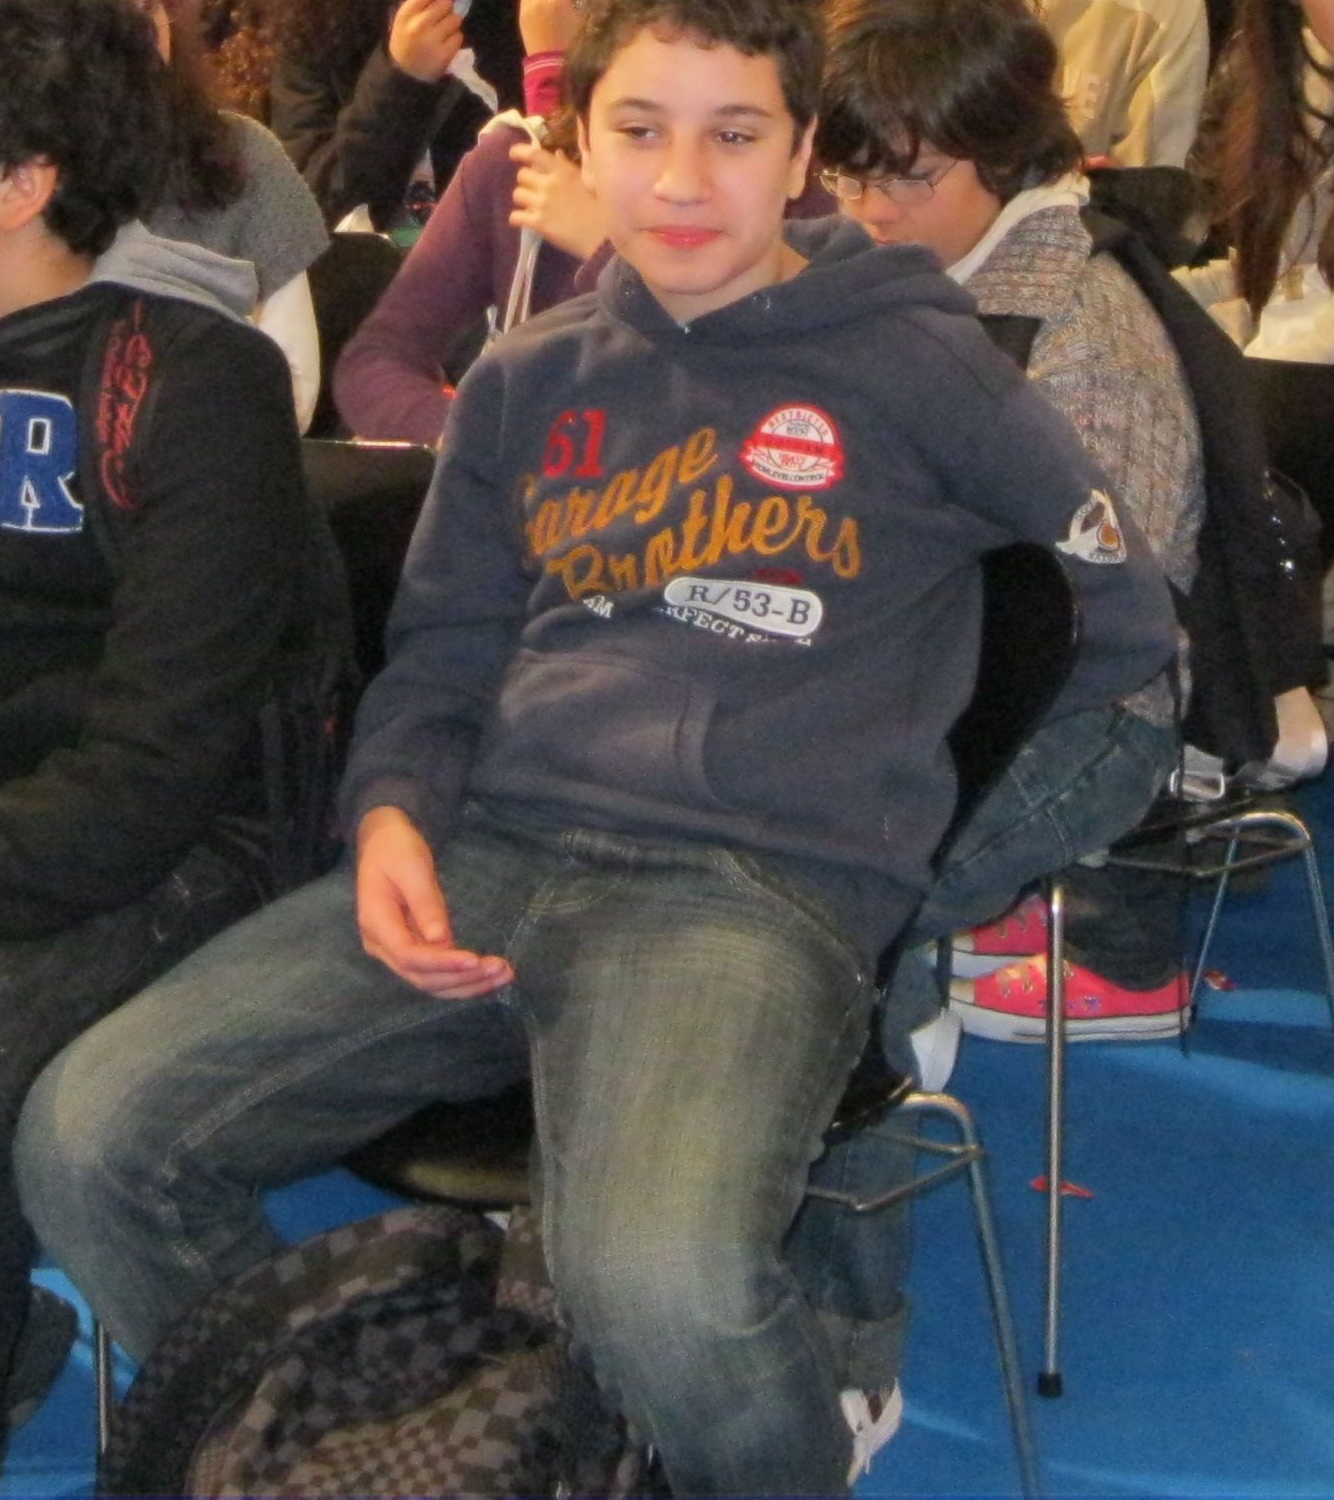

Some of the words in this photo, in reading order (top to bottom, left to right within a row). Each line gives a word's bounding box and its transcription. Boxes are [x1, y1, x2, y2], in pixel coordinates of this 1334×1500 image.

[542, 407, 608, 479] 61
[547, 475, 863, 599] Brothers
[684, 585, 811, 625] R/53-B
